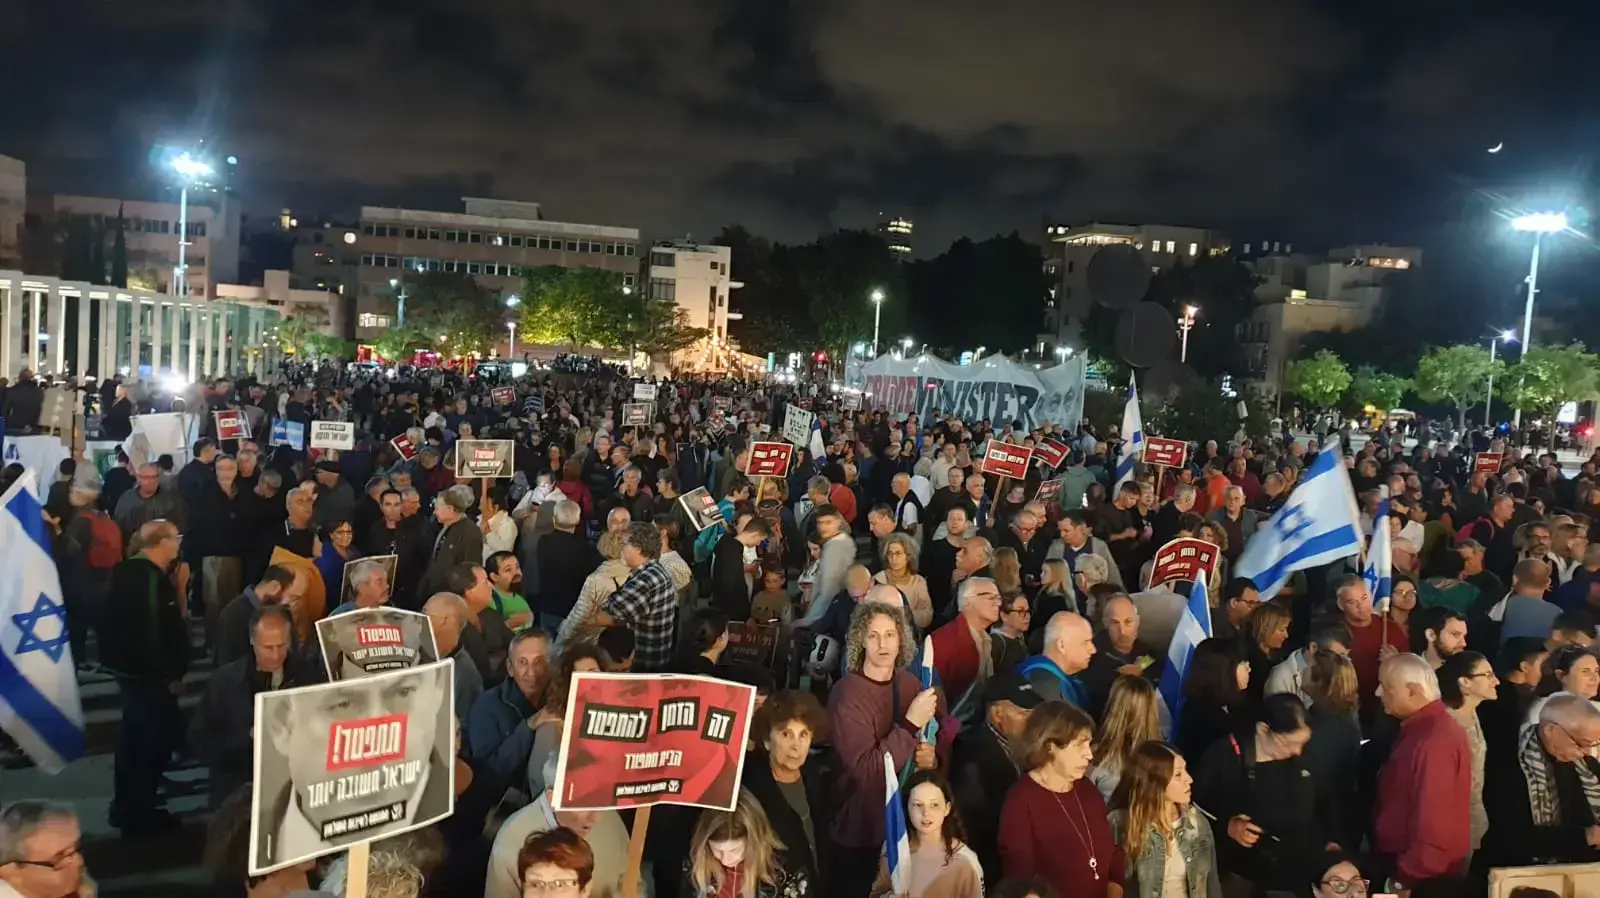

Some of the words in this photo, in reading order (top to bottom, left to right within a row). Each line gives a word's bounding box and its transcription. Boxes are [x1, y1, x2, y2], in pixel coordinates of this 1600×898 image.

[361, 627, 401, 643] תתפטר!
[587, 709, 648, 738] להתפטר
[662, 702, 695, 731] הזמן
[707, 712, 730, 739] זה
[332, 721, 402, 764] תתפטר!
[659, 750, 683, 767] הבית
[337, 770, 380, 801] חשובה
[382, 760, 421, 789] ישראל
[307, 780, 335, 808] יותר
